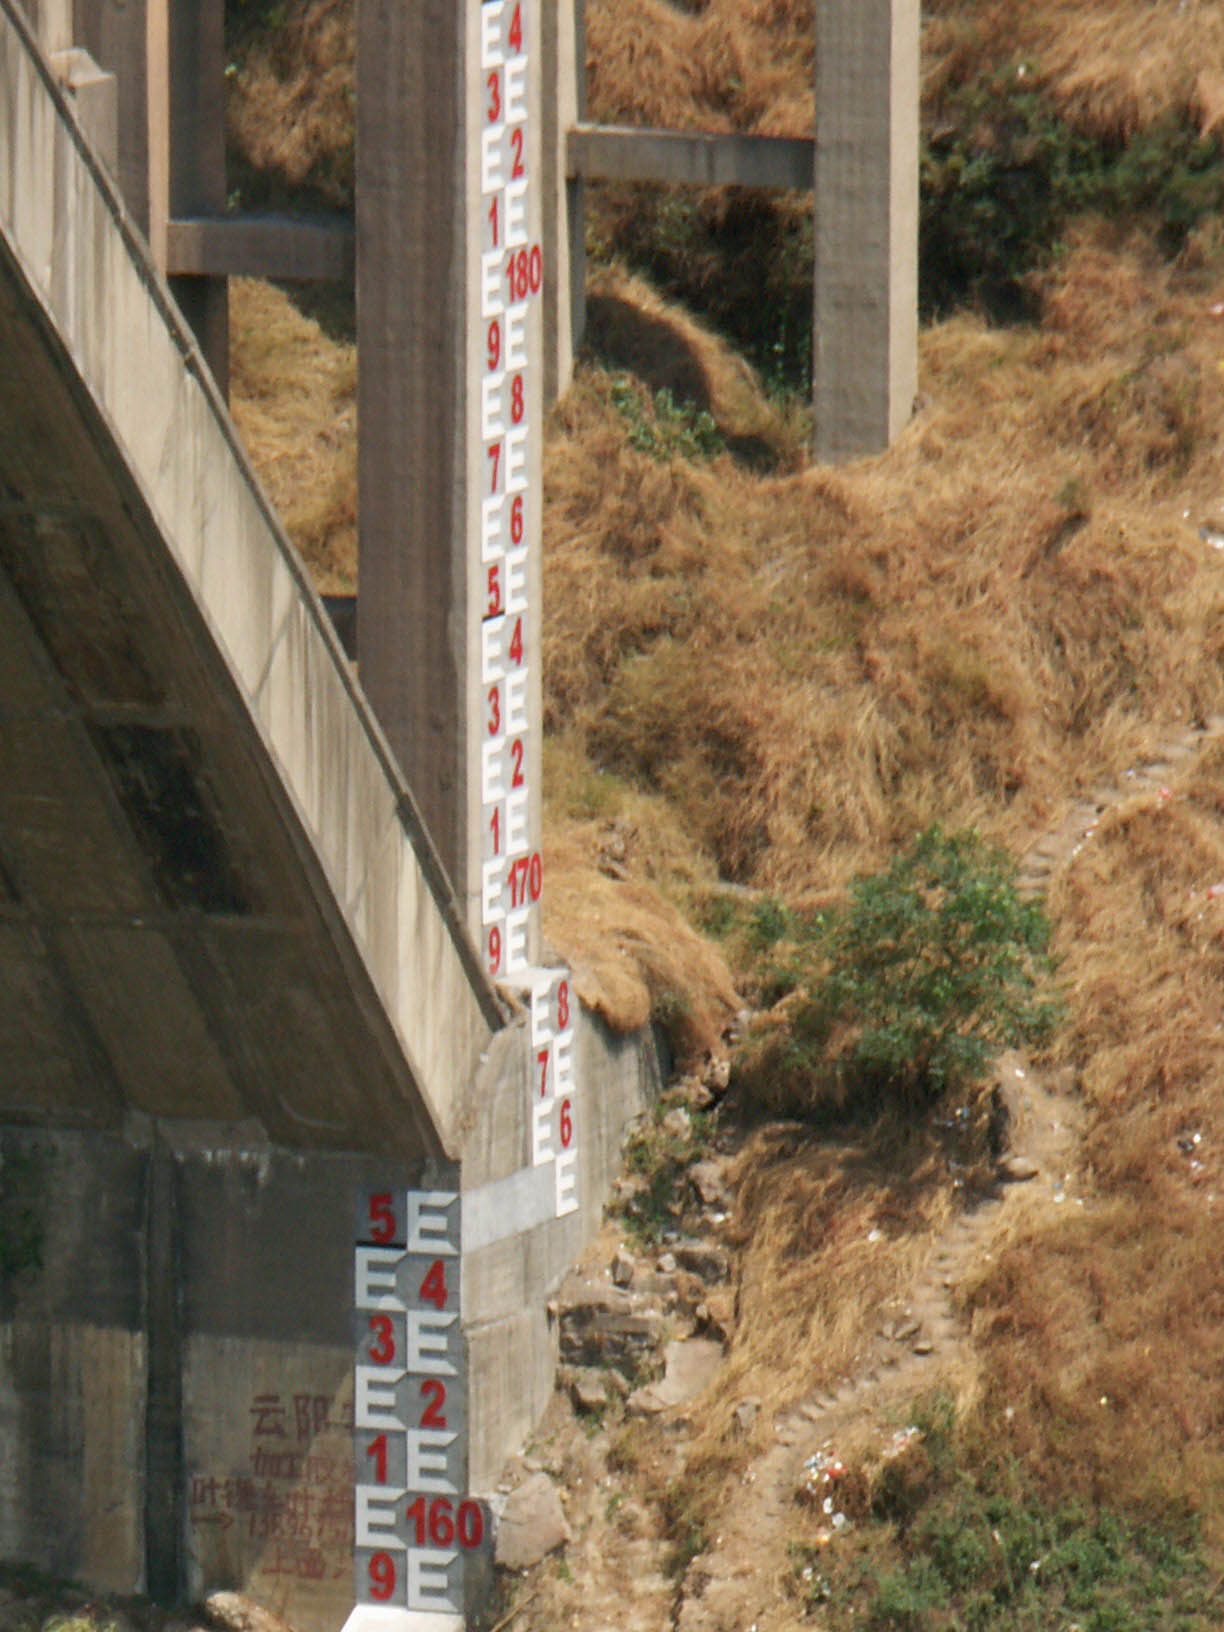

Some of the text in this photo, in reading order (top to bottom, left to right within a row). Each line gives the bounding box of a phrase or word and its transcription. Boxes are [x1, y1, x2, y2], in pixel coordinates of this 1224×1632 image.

[508, 4, 524, 54] 4
[487, 71, 502, 123] 3
[511, 127, 525, 180] 2
[487, 197, 499, 248] 1
[505, 244, 544, 303] 180
[487, 320, 502, 372] 9
[510, 373, 525, 425] 8
[487, 442, 502, 494] 7
[510, 495, 524, 545] 6
[487, 564, 502, 618] 5
[508, 617, 524, 667] 4
[487, 686, 502, 737] 3
[510, 739, 525, 789] 2
[489, 806, 500, 857] 1
[507, 852, 544, 909] 170
[487, 926, 502, 977] 9
[556, 979, 570, 1031] 8
[536, 1049, 551, 1098] 7
[559, 1098, 573, 1149] 6
[369, 1193, 397, 1245] 5
[419, 1258, 450, 1311] 4
[368, 1314, 397, 1365] 3
[419, 1378, 448, 1429] 2
[366, 1433, 389, 1485] 1
[406, 1494, 485, 1551] 160
[368, 1551, 397, 1601] 9
